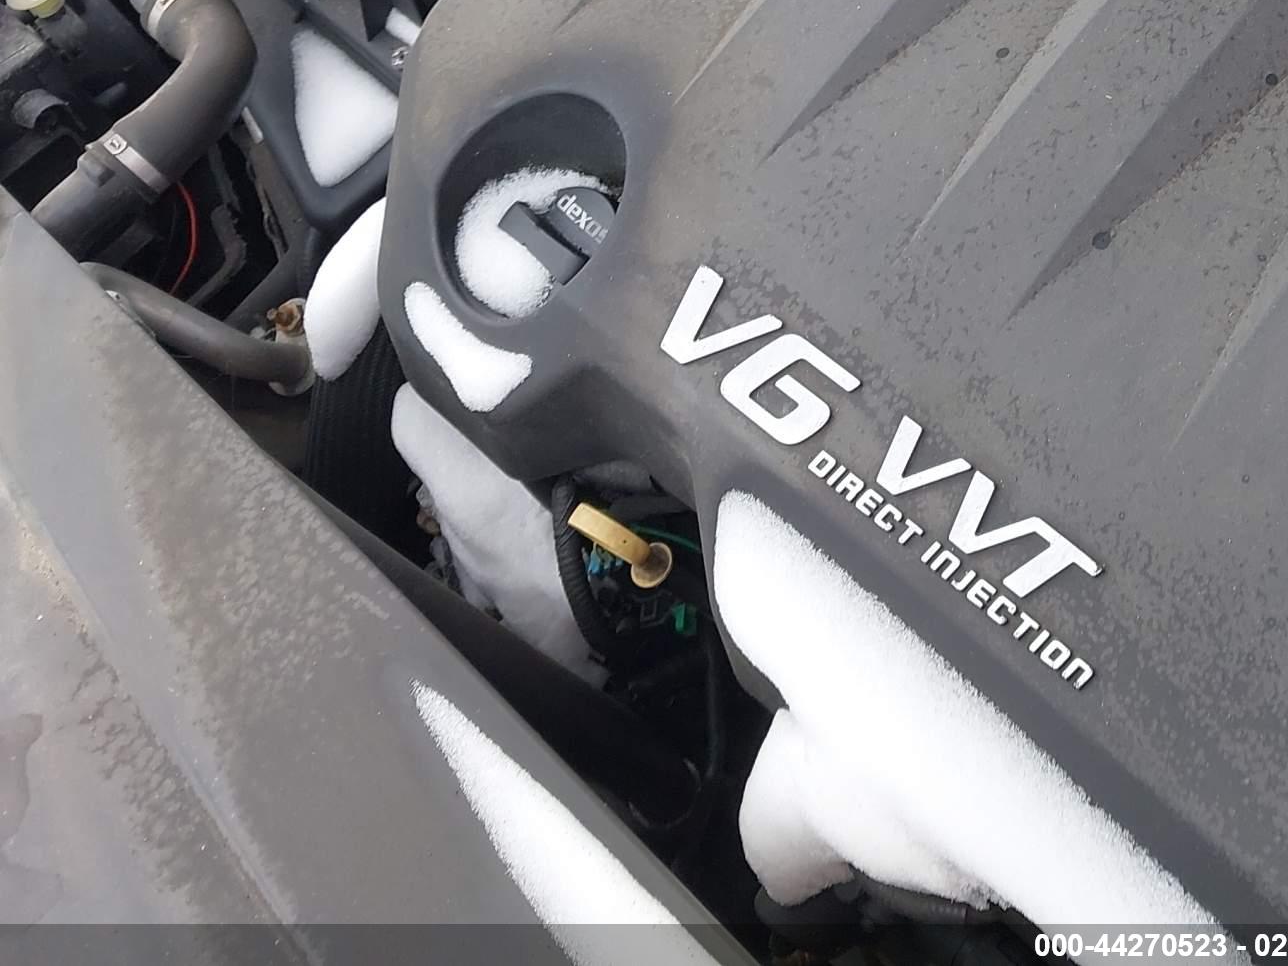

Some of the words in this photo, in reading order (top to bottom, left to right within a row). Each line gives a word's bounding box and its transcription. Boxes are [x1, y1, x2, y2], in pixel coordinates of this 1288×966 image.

[660, 265, 861, 445] V6
[876, 415, 1103, 598] VVT
[807, 450, 925, 546] DIRECT
[920, 541, 1095, 690] INJECTION
